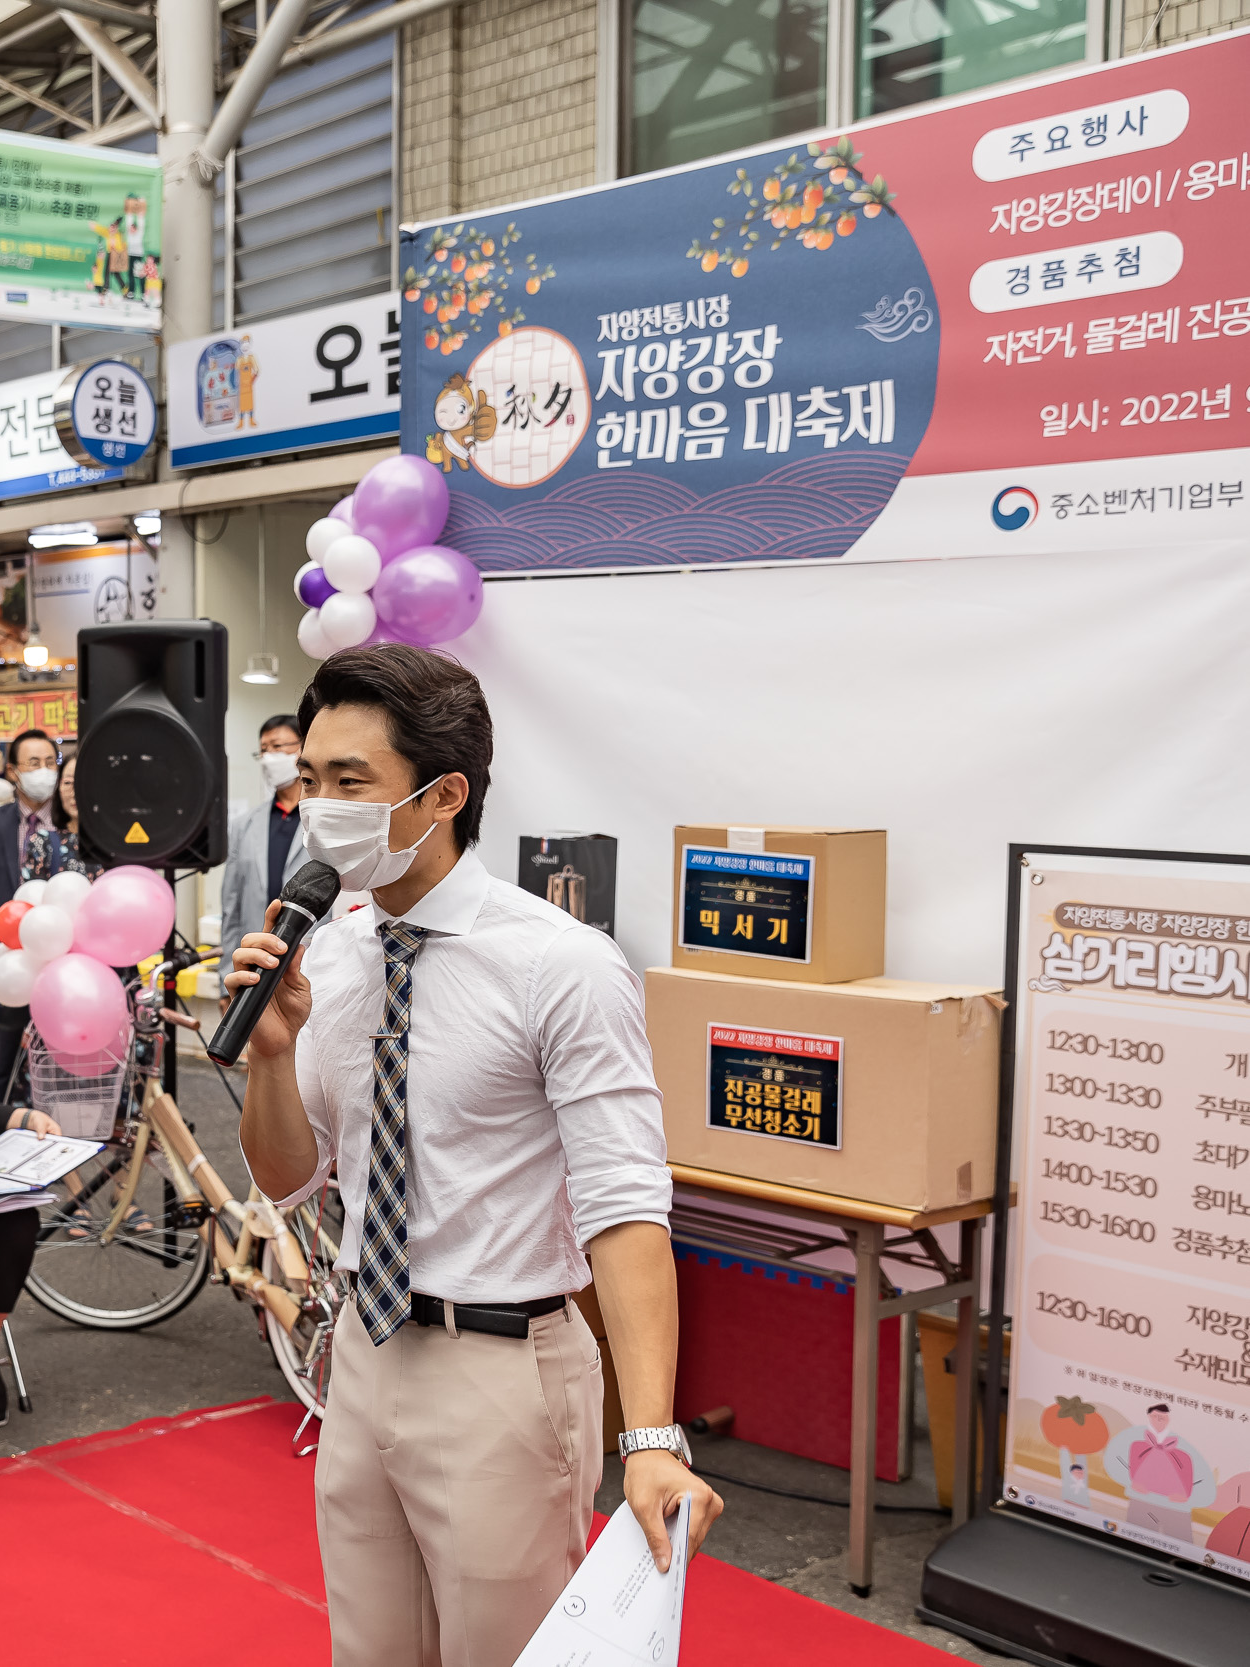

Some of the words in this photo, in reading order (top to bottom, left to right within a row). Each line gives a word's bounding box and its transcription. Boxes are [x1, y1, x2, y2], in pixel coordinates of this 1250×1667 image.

[1008, 103, 1149, 164] 주요행사
[989, 170, 1161, 236] 자양강장데이
[1005, 245, 1141, 297] 경품추첨
[596, 293, 731, 343] 자양전통시장
[983, 321, 1077, 367] 자전거,
[1083, 306, 1181, 357] 물걸레
[595, 324, 783, 403] 자양강장
[94, 374, 137, 407] 오늘
[1040, 397, 1110, 438] 일시:
[1119, 383, 1232, 428] 2022년
[92, 406, 137, 438] 생선
[595, 400, 731, 470] 한마음
[742, 378, 895, 454] 대축제
[1050, 480, 1244, 520] 중소벤처기업부
[699, 908, 788, 945] 믹서기
[1063, 906, 1161, 933] 자양전통시장
[1161, 914, 1232, 940] 자양강장
[1047, 1029, 1165, 1065] 12:30~13:00
[724, 1079, 822, 1116] 진공물걸레
[1045, 1072, 1162, 1110] 13:00~13:30
[724, 1103, 821, 1141] 무선청소기
[1044, 1115, 1160, 1154] 13:30~13:50
[1041, 1157, 1158, 1199] 14:00~15:30
[1039, 1201, 1156, 1243] 15:30~16:00
[1036, 1291, 1151, 1338] 12:30~16:00
